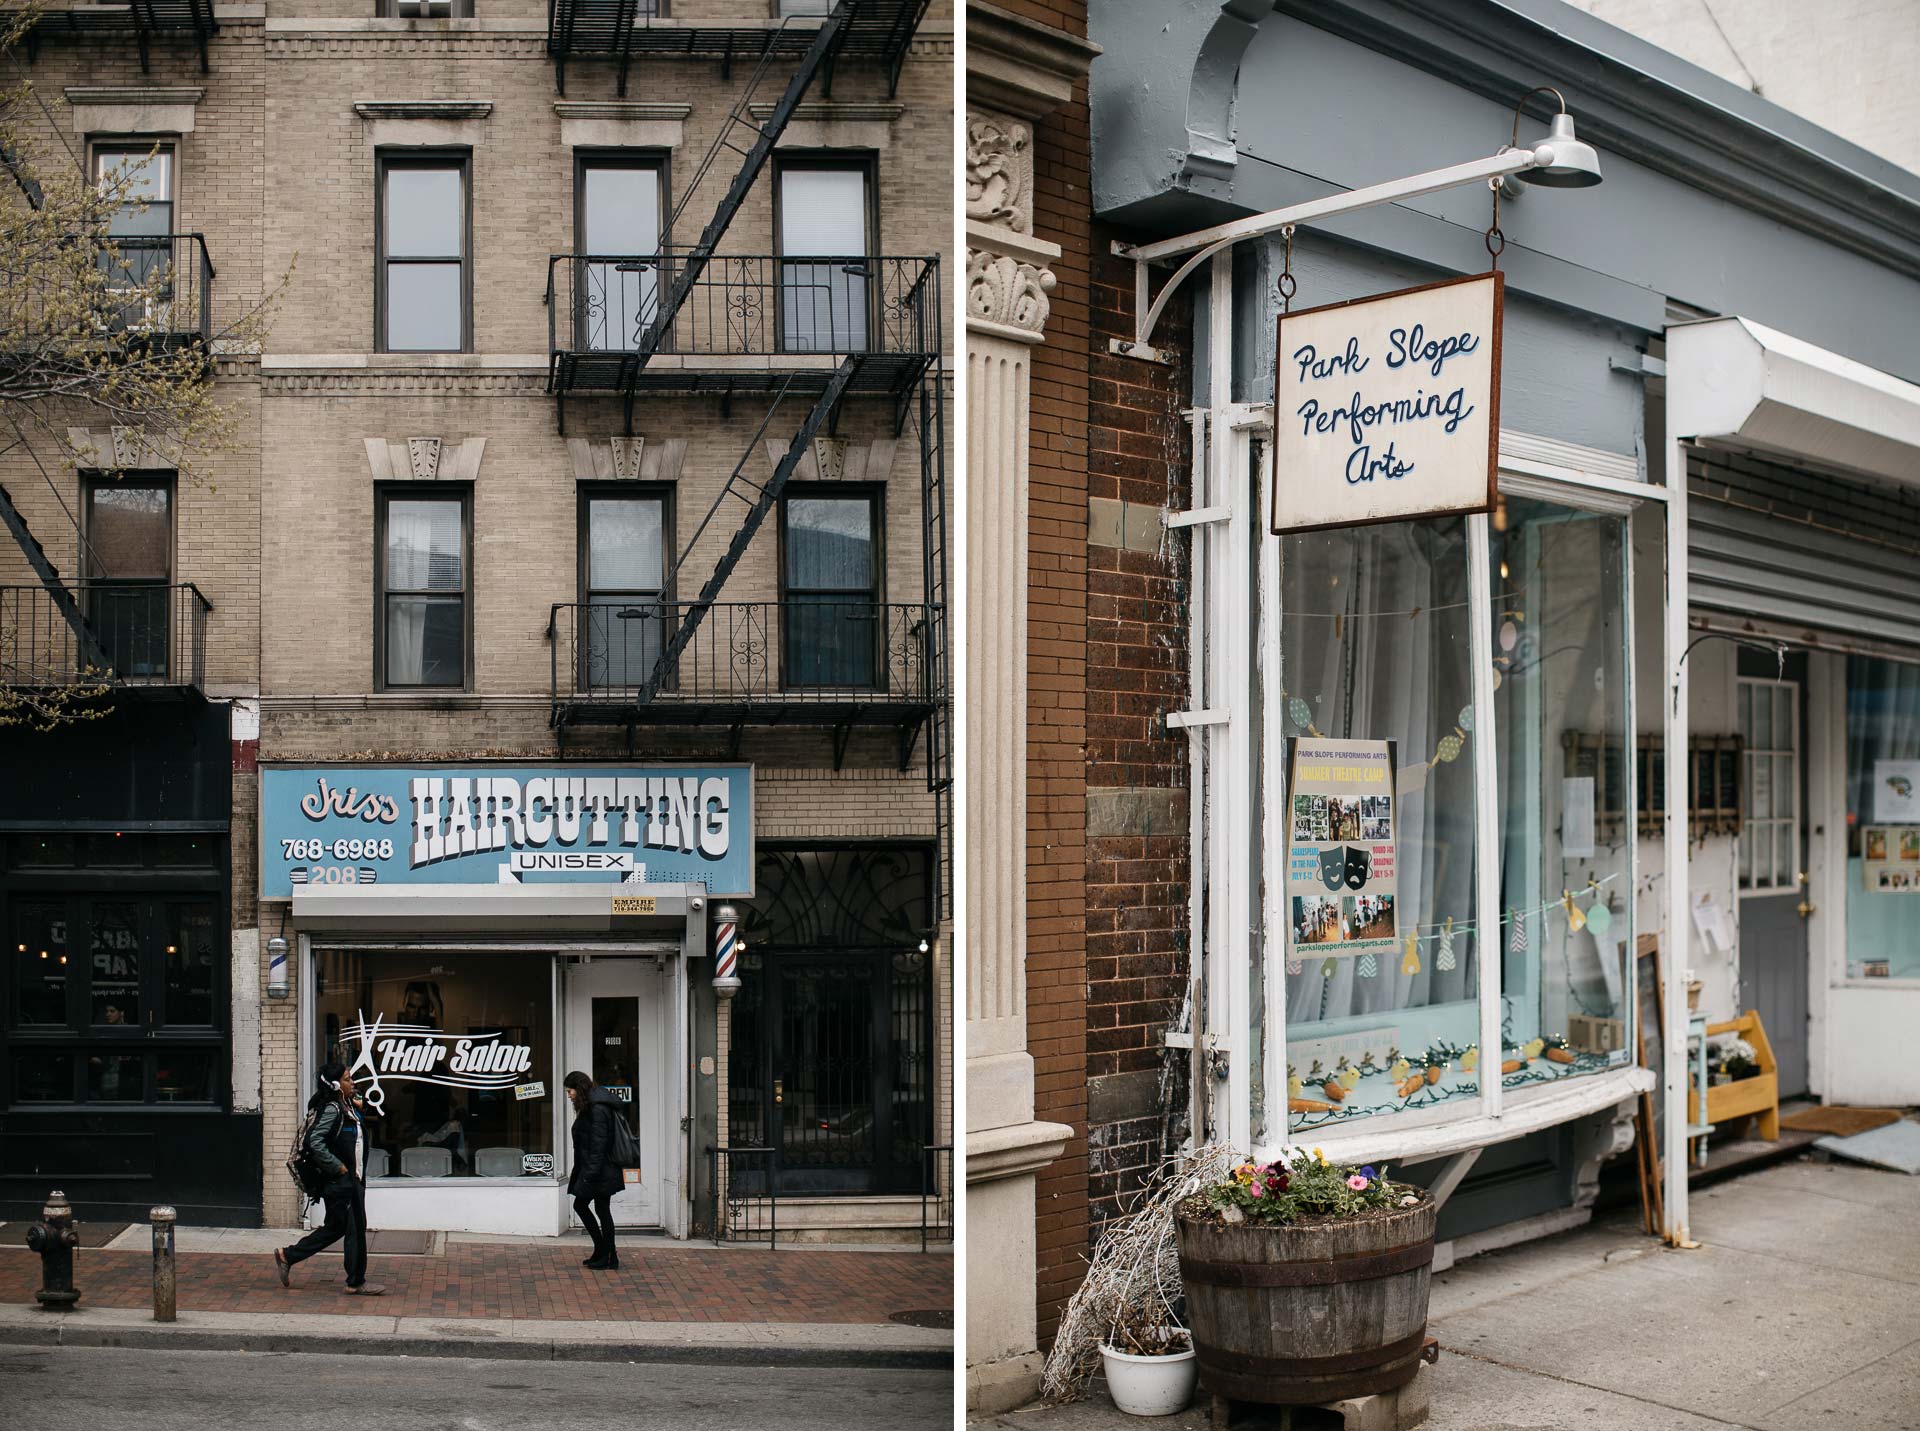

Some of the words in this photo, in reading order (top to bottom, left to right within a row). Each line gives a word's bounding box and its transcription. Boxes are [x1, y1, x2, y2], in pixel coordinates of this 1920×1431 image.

[1293, 337, 1370, 383] Park
[1386, 323, 1479, 377] Slope
[1297, 387, 1474, 444] Performing
[1345, 442, 1414, 484] Arts
[1297, 750, 1313, 758] PARK
[1335, 751, 1371, 759] PERFORMING
[1372, 752, 1387, 760] ARTS
[1299, 766, 1330, 781] SUMMER
[1333, 767, 1362, 782] THEATRE
[1364, 768, 1385, 783] CAMP
[408, 777, 730, 870] HAIRCUTTING
[280, 838, 393, 862] 768-6988
[519, 854, 625, 869] UNISEX
[311, 866, 356, 884] 208
[1296, 940, 1394, 954] parkslopeperformingarts.com
[377, 1037, 447, 1073] Hair
[450, 1038, 532, 1073] Salon
